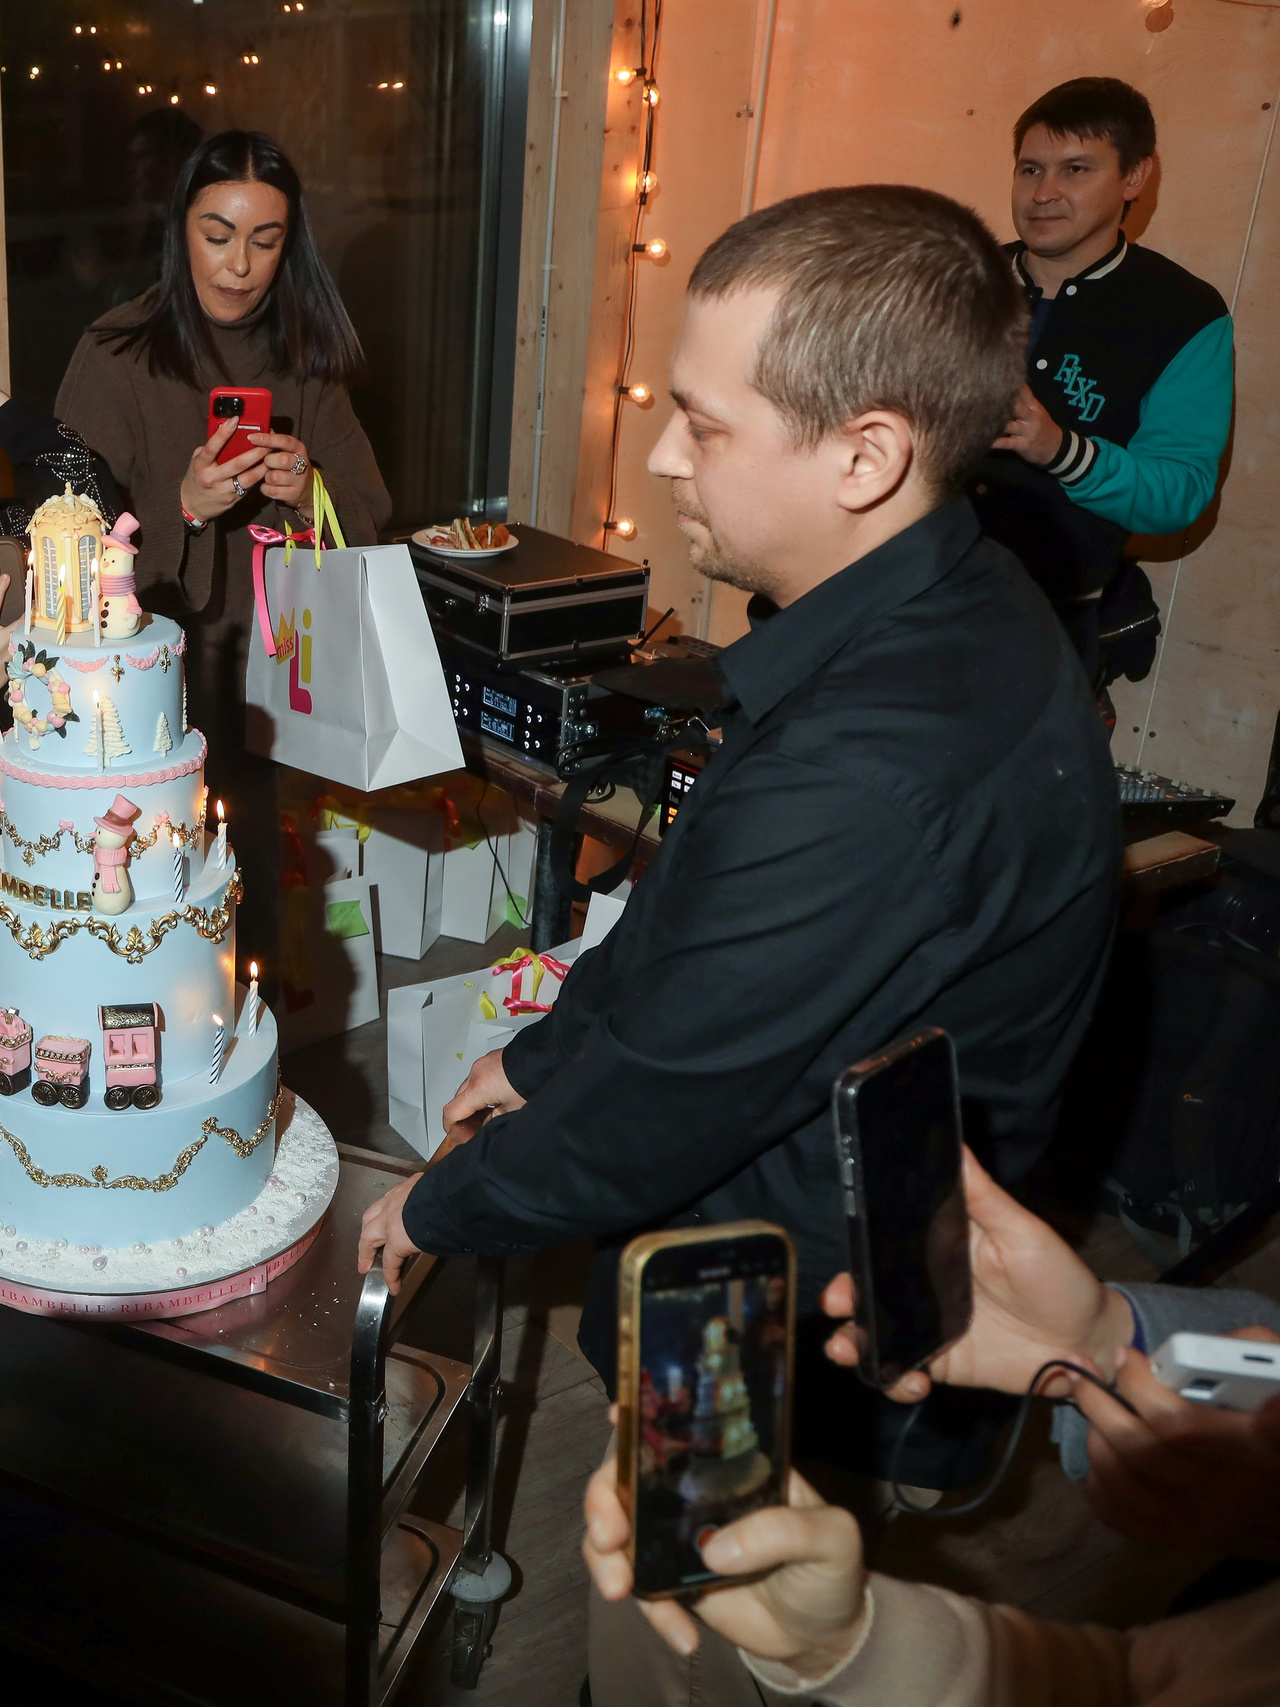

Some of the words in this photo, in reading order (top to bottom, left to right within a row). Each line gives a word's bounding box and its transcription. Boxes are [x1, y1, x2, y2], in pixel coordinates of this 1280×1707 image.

[1053, 353, 1106, 422] RLXD
[276, 637, 294, 659] miss
[121, 1284, 238, 1313] RIBAMBELLE
